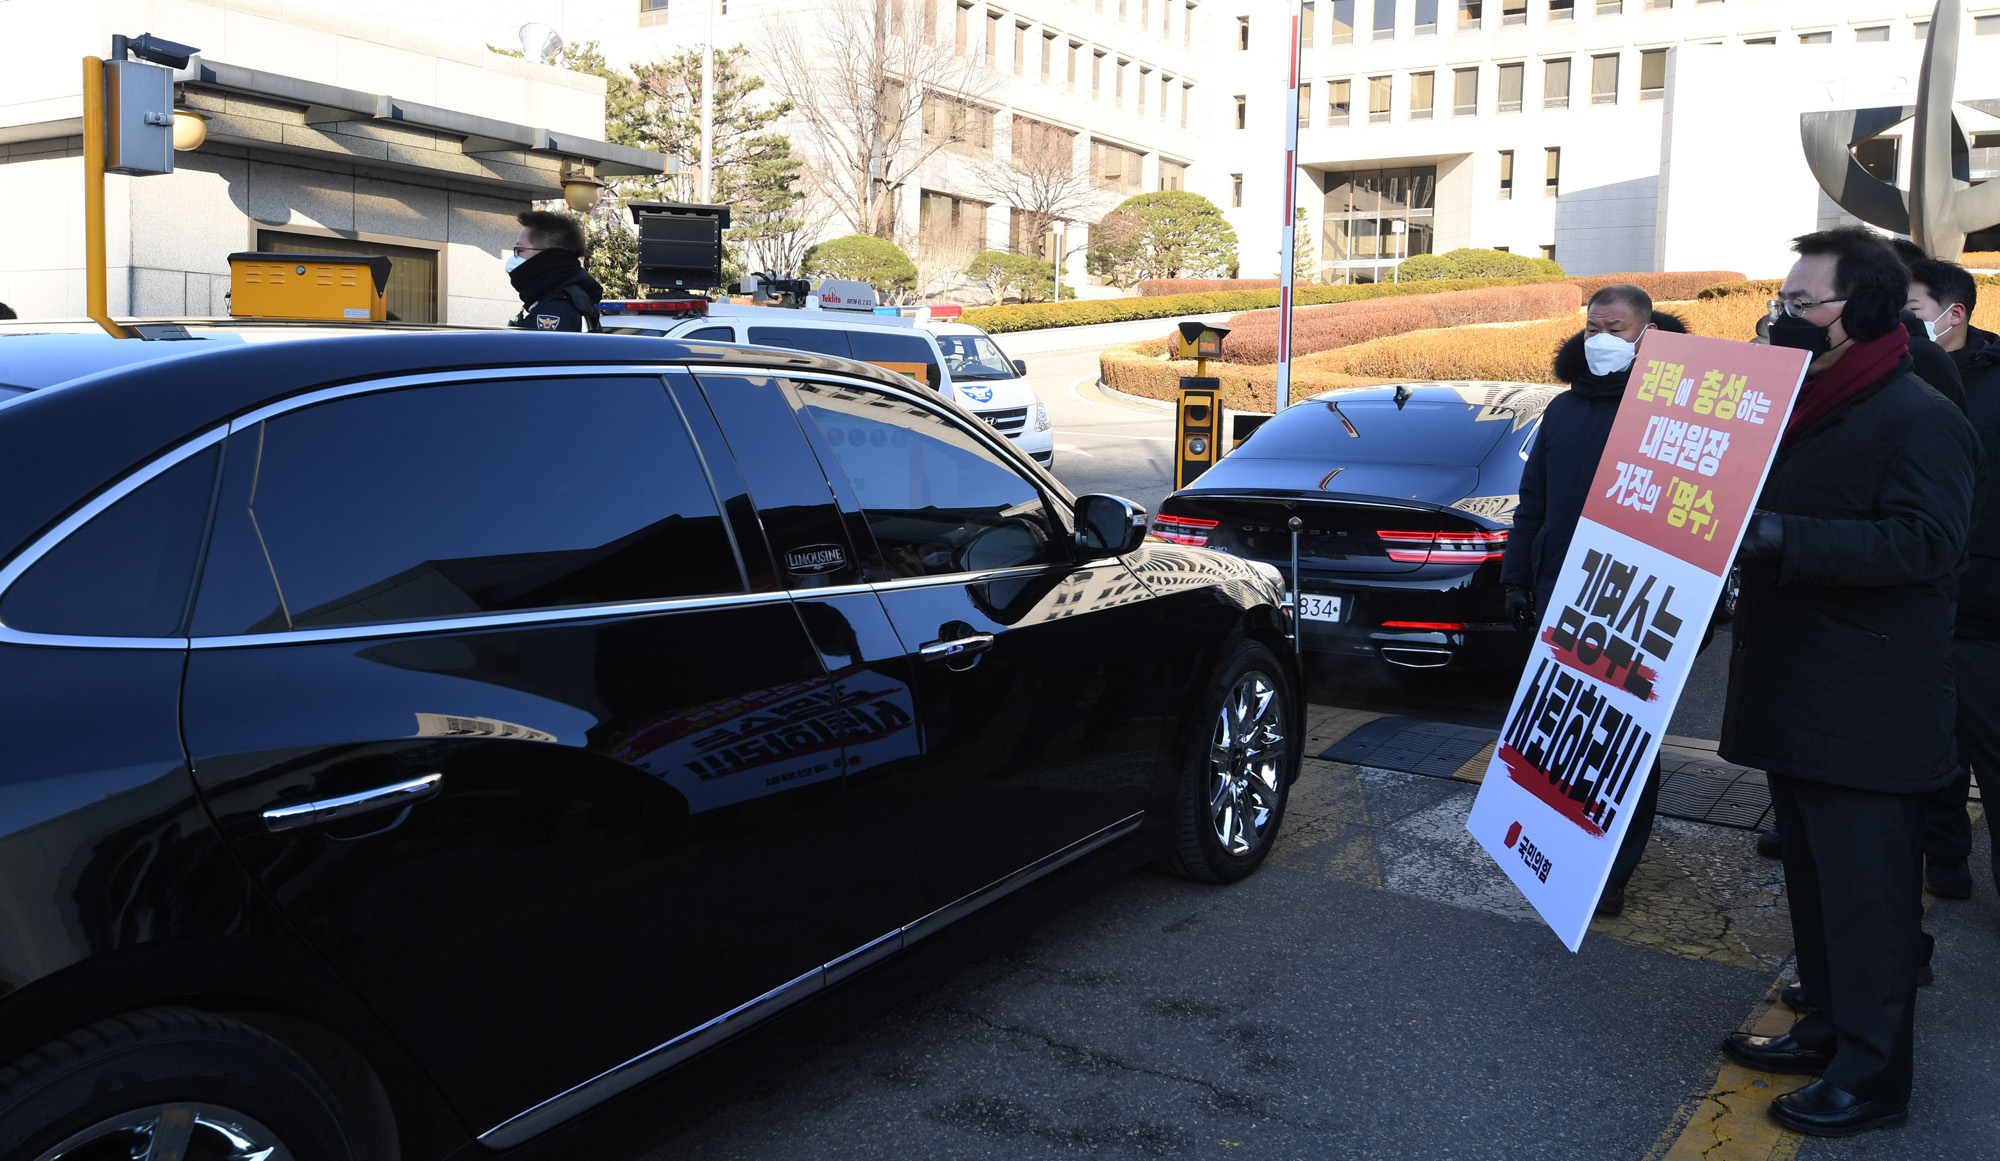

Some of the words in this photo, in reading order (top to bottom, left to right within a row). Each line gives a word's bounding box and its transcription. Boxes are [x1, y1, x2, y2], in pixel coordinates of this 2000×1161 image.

[822, 292, 841, 303] Teklite
[1636, 359, 1695, 407] 권력에
[1693, 369, 1772, 425] 충성하는
[1638, 415, 1731, 477] 대법원장
[1605, 461, 1662, 514] 거짓의
[1665, 476, 1719, 542] 「명수」
[788, 548, 842, 567] LIMOUSINE
[1551, 548, 1684, 702] 김명수는
[1504, 657, 1652, 833] 사퇴하라!!
[1518, 835, 1553, 884] 국민의힘
